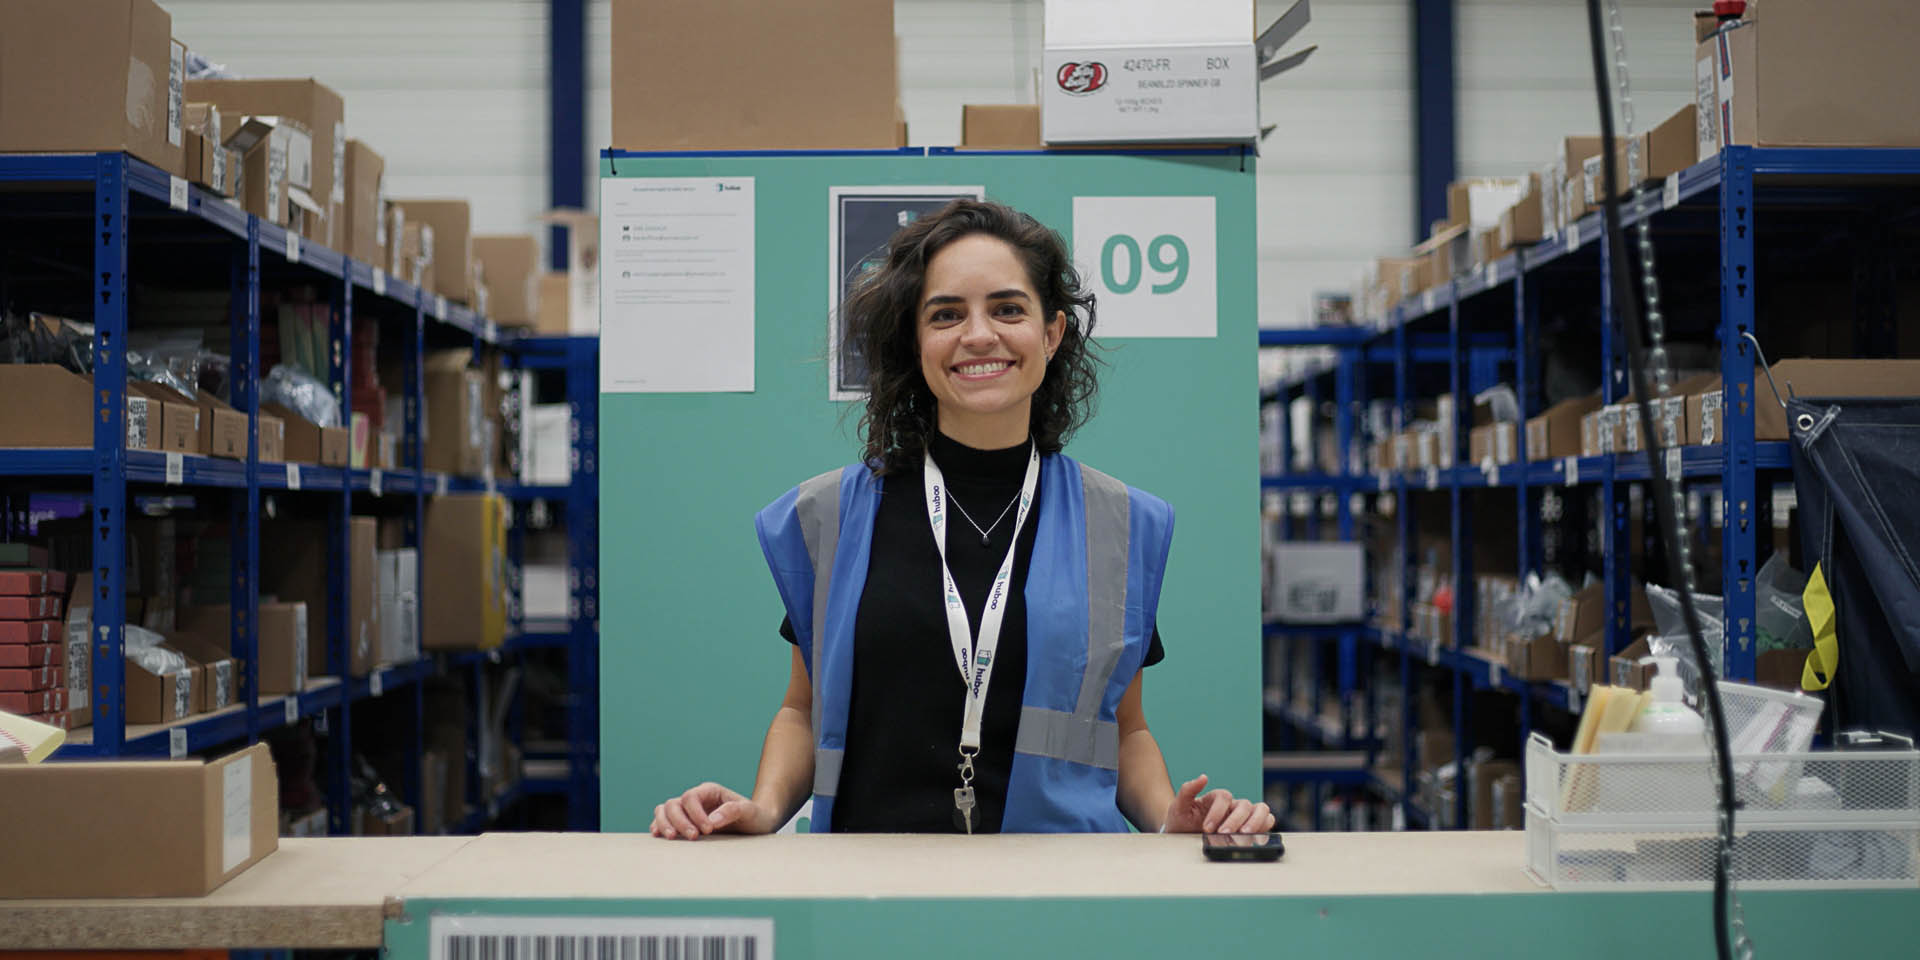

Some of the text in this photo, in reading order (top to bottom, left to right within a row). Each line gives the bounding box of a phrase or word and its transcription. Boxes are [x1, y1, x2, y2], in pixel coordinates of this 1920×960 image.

[1206, 57, 1230, 70] BOX
[1100, 233, 1190, 295] 09
[932, 485, 940, 514] huboo
[990, 581, 1005, 610] huboo
